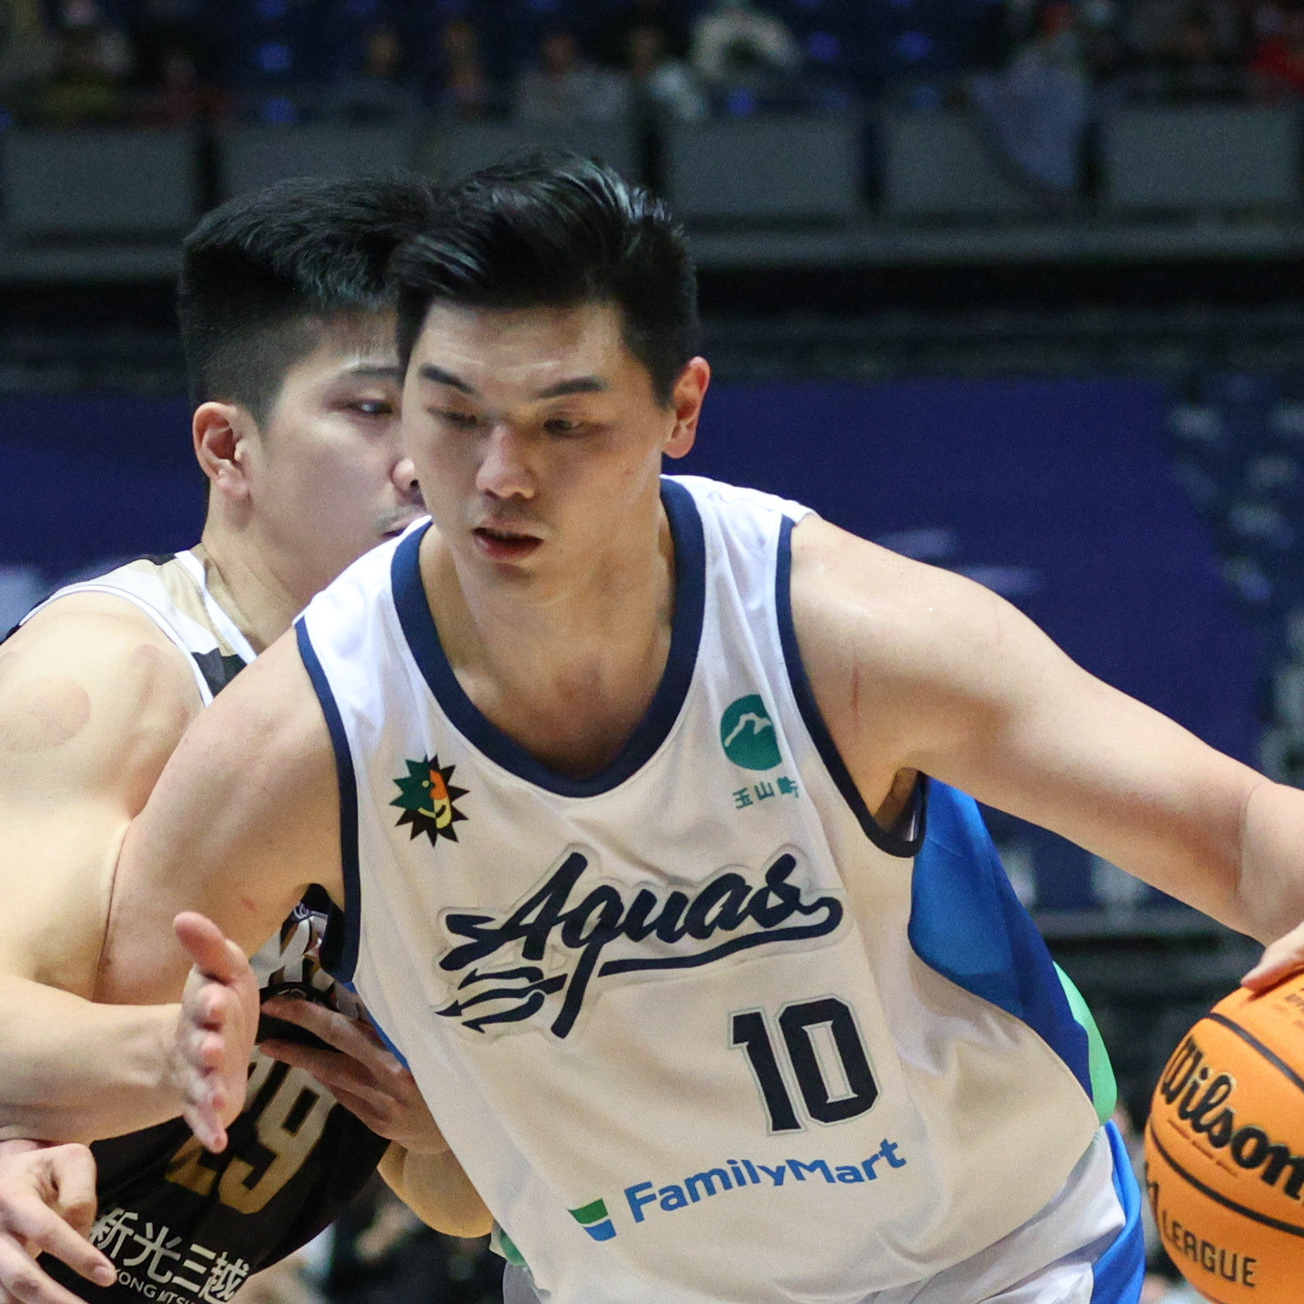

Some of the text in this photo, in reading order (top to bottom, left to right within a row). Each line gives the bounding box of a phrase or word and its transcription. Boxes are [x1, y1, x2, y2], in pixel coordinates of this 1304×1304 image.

[438, 851, 845, 1040] Aquas
[727, 993, 884, 1137] 10
[623, 1137, 907, 1224] FamilyMart
[1160, 1209, 1258, 1289] LEAGUE
